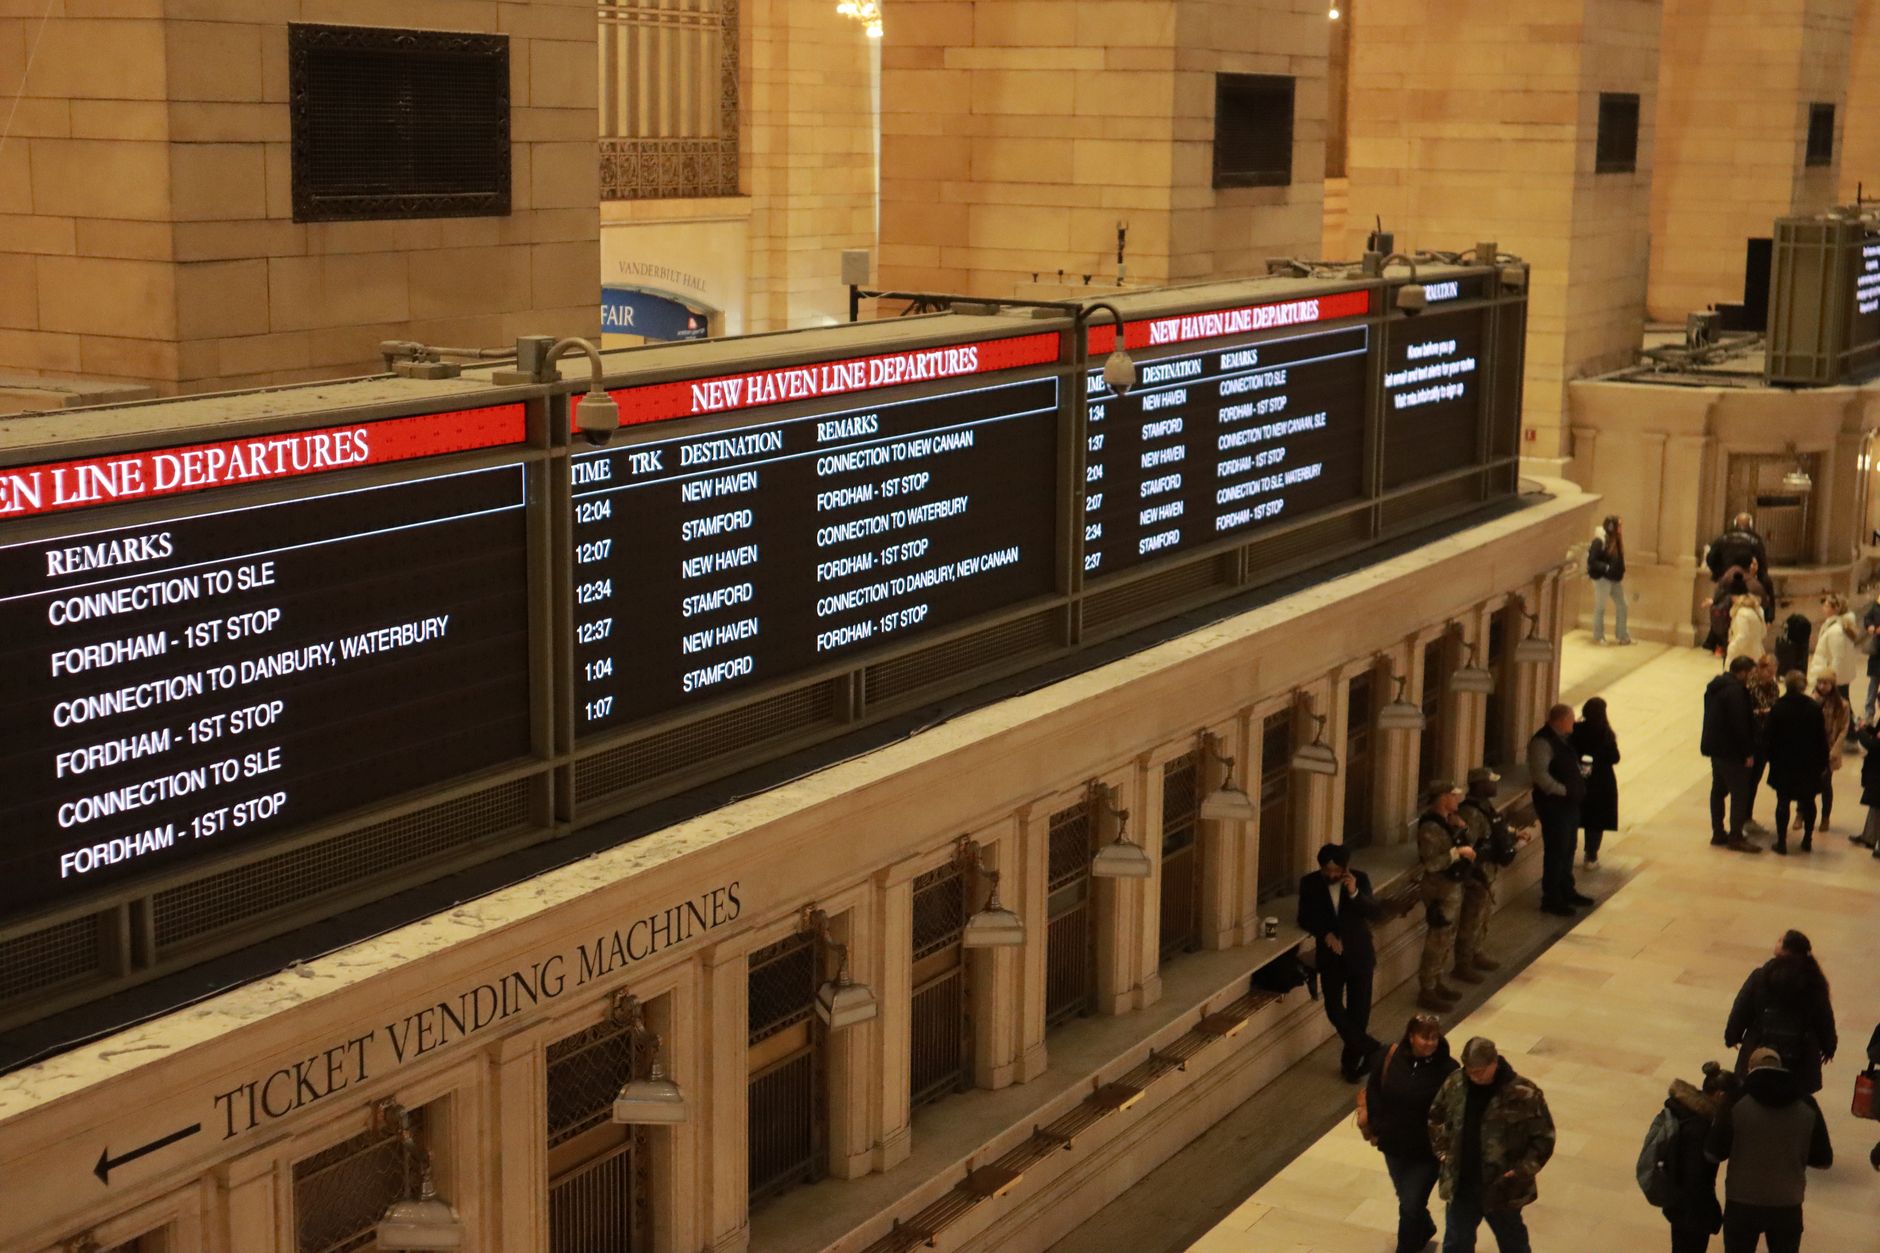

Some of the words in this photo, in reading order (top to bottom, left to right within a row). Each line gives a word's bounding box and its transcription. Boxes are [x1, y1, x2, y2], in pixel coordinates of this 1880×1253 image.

[619, 261, 681, 285] VANDERBILT
[683, 273, 706, 292] HALL
[601, 304, 634, 326] FAIR
[1150, 319, 1180, 343] NEW
[1181, 313, 1223, 339] HAVEN
[1224, 310, 1251, 333] LINE
[1253, 300, 1318, 328] DEPARTURES
[1143, 359, 1201, 383] DESTINATION
[1221, 349, 1257, 369] REMARKS
[692, 379, 742, 411] NEW
[747, 368, 817, 403] HAVEN
[821, 362, 866, 392] LINE
[869, 347, 977, 385] DEPARTURES
[1087, 375, 1105, 393] IME
[1220, 375, 1261, 395] CONNECTION
[1261, 372, 1273, 387] TO
[1273, 370, 1286, 385] SLE
[1089, 405, 1104, 421] 1:34
[1143, 394, 1163, 410] NEW
[1163, 389, 1186, 406] HAVEN
[1219, 403, 1252, 422] FORDHAM
[1257, 399, 1268, 414] 1ST
[1268, 396, 1286, 412] STOP
[817, 414, 877, 441] REMARKS
[1142, 418, 1182, 440] STAMFORD
[1218, 428, 1261, 450] CONNECTION
[1260, 425, 1271, 440] TO
[1271, 422, 1287, 436] NEW
[1314, 413, 1326, 427] SLE
[680, 431, 781, 465] DESTINATION
[817, 446, 889, 476] CONNECTION
[891, 443, 906, 460] TO
[908, 438, 931, 457] NEW
[933, 430, 972, 453] CANAAN
[1088, 434, 1104, 451] 1:37
[1142, 450, 1162, 468] NEW
[1162, 445, 1184, 462] HAVEN
[51, 460, 144, 504] LINE
[153, 429, 368, 490] DEPARTURES
[571, 459, 610, 485] TIME
[629, 450, 662, 474] TRK
[1087, 464, 1102, 481] 2:04
[1218, 456, 1251, 476] FORDHAM
[1256, 452, 1268, 467] 1ST
[1268, 448, 1285, 464] STOP
[682, 479, 712, 502] NEW
[716, 471, 756, 496] HAVEN
[818, 484, 872, 511] FORDHAM
[881, 478, 900, 497] 1ST
[902, 472, 928, 493] STOP
[1141, 474, 1181, 497] STAMFORD
[1217, 481, 1259, 504] CONNECTION
[1259, 477, 1270, 492] TO
[1285, 463, 1321, 484] WATERBURY
[576, 499, 611, 523] 12:04
[1086, 494, 1102, 511] 2:07
[1140, 507, 1160, 525] NEW
[1160, 501, 1183, 519] HAVEN
[1216, 509, 1249, 530] FORDHAM
[1254, 504, 1266, 519] 1ST
[1266, 500, 1283, 516] STOP
[682, 510, 751, 541] STAMFORD
[817, 514, 888, 546] CONNECTION
[891, 511, 905, 528] TO
[907, 496, 967, 525] WATERBURY
[1085, 523, 1101, 540] 2:34
[46, 532, 172, 576] REMARKS
[576, 539, 611, 563] 12:07
[1139, 530, 1179, 554] STAMFORD
[683, 555, 713, 578] NEW
[716, 545, 756, 570] HAVEN
[818, 552, 871, 581] FORDHAM
[881, 546, 899, 565] 1ST
[901, 539, 928, 560] STOP
[1085, 552, 1101, 570] 2:37
[49, 576, 198, 625] CONNECTION
[203, 570, 232, 595] TO
[238, 562, 274, 590] SLE
[576, 579, 611, 603] 12:34
[817, 582, 888, 616] CONNECTION
[890, 578, 904, 595] TO
[907, 564, 954, 592] DANBURY,
[957, 557, 979, 577] NEW
[981, 547, 1018, 570] CANAAN
[683, 583, 752, 617] STAMFORD
[577, 618, 612, 643] 12:37
[683, 630, 713, 654] NEW
[716, 617, 757, 645] HAVEN
[818, 620, 871, 651] FORDHAM
[880, 612, 898, 632] 1ST
[901, 604, 927, 627] STOP
[52, 631, 166, 677] FORDHAM
[185, 620, 222, 648] 1ST
[227, 608, 280, 639] STOP
[54, 672, 202, 727] CONNECTION
[207, 665, 236, 690] TO
[241, 642, 335, 684] DANBURY,
[340, 615, 448, 659] WATERBURY
[585, 658, 612, 681] 1:04
[683, 656, 752, 692] STAMFORD
[586, 696, 612, 720] 1:07
[57, 728, 169, 778] FORDHAM
[188, 714, 225, 744] 1ST
[230, 701, 283, 733] STOP
[58, 767, 205, 827] CONNECTION
[210, 759, 239, 785] TO
[244, 747, 281, 777] SLE
[61, 824, 173, 878] FORDHAM
[192, 808, 228, 838] 1ST
[233, 792, 286, 826] STOP
[214, 1030, 374, 1140] TICKET
[385, 955, 565, 1064] VENDING
[577, 881, 741, 985] MACHINES
